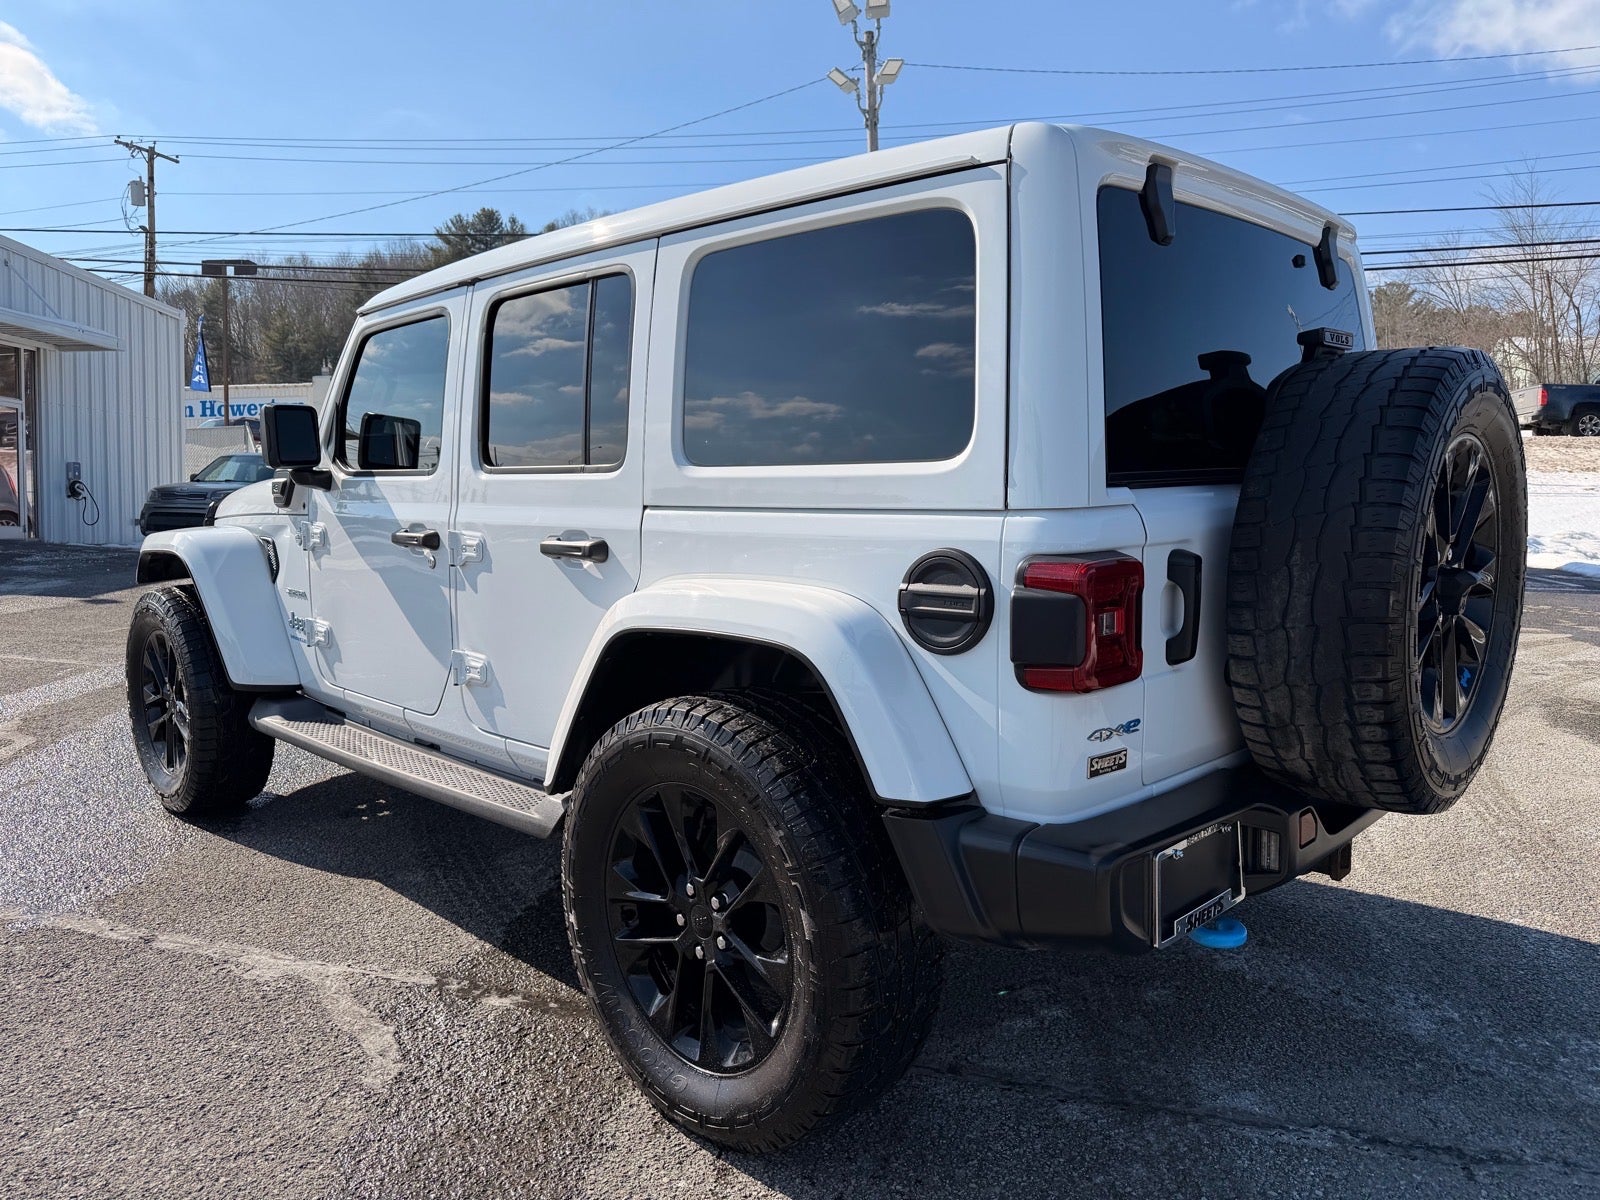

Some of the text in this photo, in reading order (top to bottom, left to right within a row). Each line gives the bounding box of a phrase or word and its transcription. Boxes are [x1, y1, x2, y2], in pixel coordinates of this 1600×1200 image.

[1330, 333, 1349, 345] VOLS
[1091, 751, 1127, 770] SHEETS
[1185, 900, 1224, 933] SHEETS
